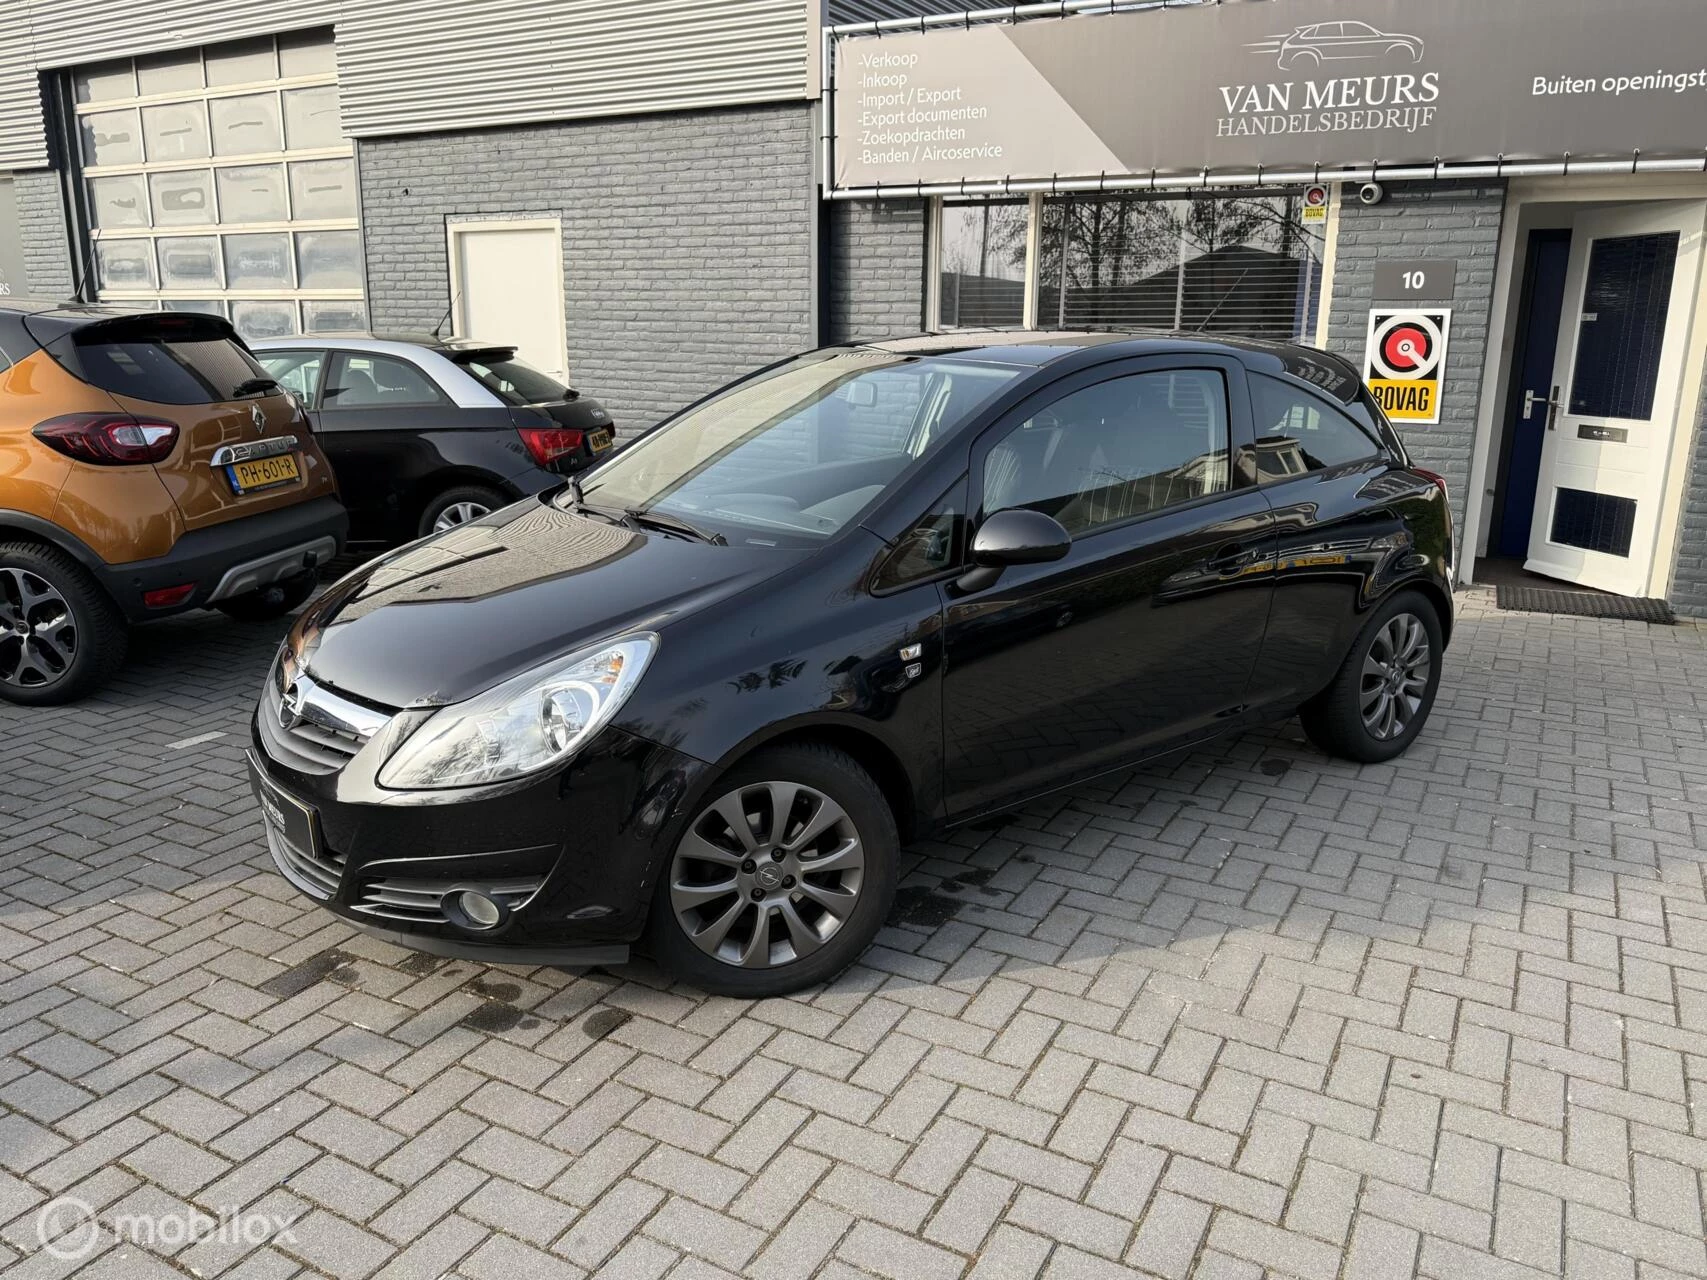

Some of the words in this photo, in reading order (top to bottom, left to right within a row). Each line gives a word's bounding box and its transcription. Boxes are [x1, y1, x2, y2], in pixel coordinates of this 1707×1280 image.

[858, 51, 918, 69] -Verkoop
[858, 71, 908, 89] -Inkoop
[1532, 75, 1597, 96] Buiten
[1601, 69, 1707, 96] openingst
[858, 91, 905, 110] -Import
[907, 87, 915, 106] /
[917, 86, 962, 106] Export
[1219, 82, 1294, 114] VAN
[1302, 72, 1440, 110] MEURS
[858, 111, 905, 129] -Export
[907, 106, 988, 124] documenten
[1216, 106, 1437, 137] HANDELSBEDRIJF
[858, 126, 965, 146] -Zoekopdrachten
[858, 147, 910, 165] -Banden
[911, 145, 919, 163] /
[921, 141, 1003, 161] Aircoservice
[1402, 270, 1425, 290] 10
[1373, 386, 1430, 412] BOVAG
[240, 457, 295, 485] PH-601-R
